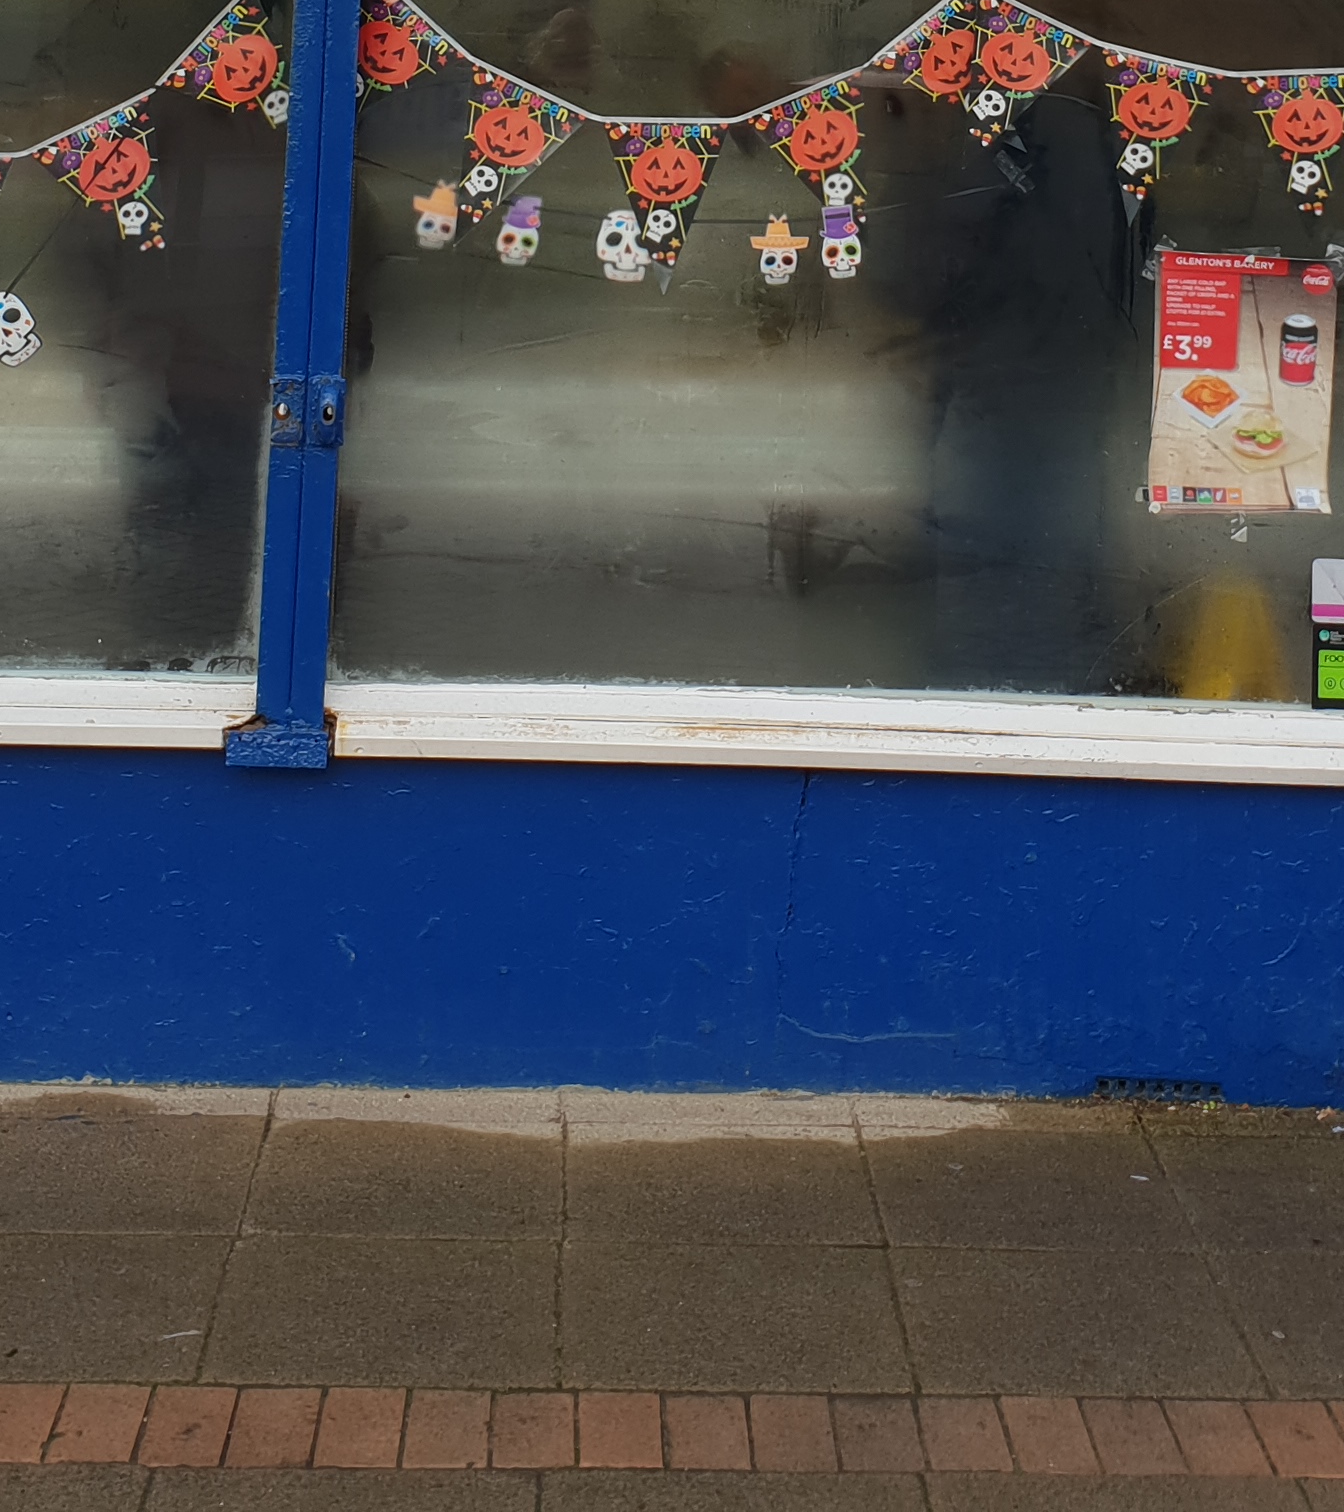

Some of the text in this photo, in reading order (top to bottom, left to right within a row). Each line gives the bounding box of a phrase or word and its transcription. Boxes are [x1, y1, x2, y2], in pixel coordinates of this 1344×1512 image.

[181, 4, 249, 72] Halloween
[997, 0, 1073, 48] Halloween
[1125, 54, 1208, 87] Halloween
[492, 75, 569, 123] Halloween
[771, 80, 850, 121] Halloween
[57, 106, 138, 153] Halloween
[629, 122, 711, 139] Halloween
[1175, 256, 1232, 268] GLENTON'S
[1163, 335, 1212, 360] £3.99
